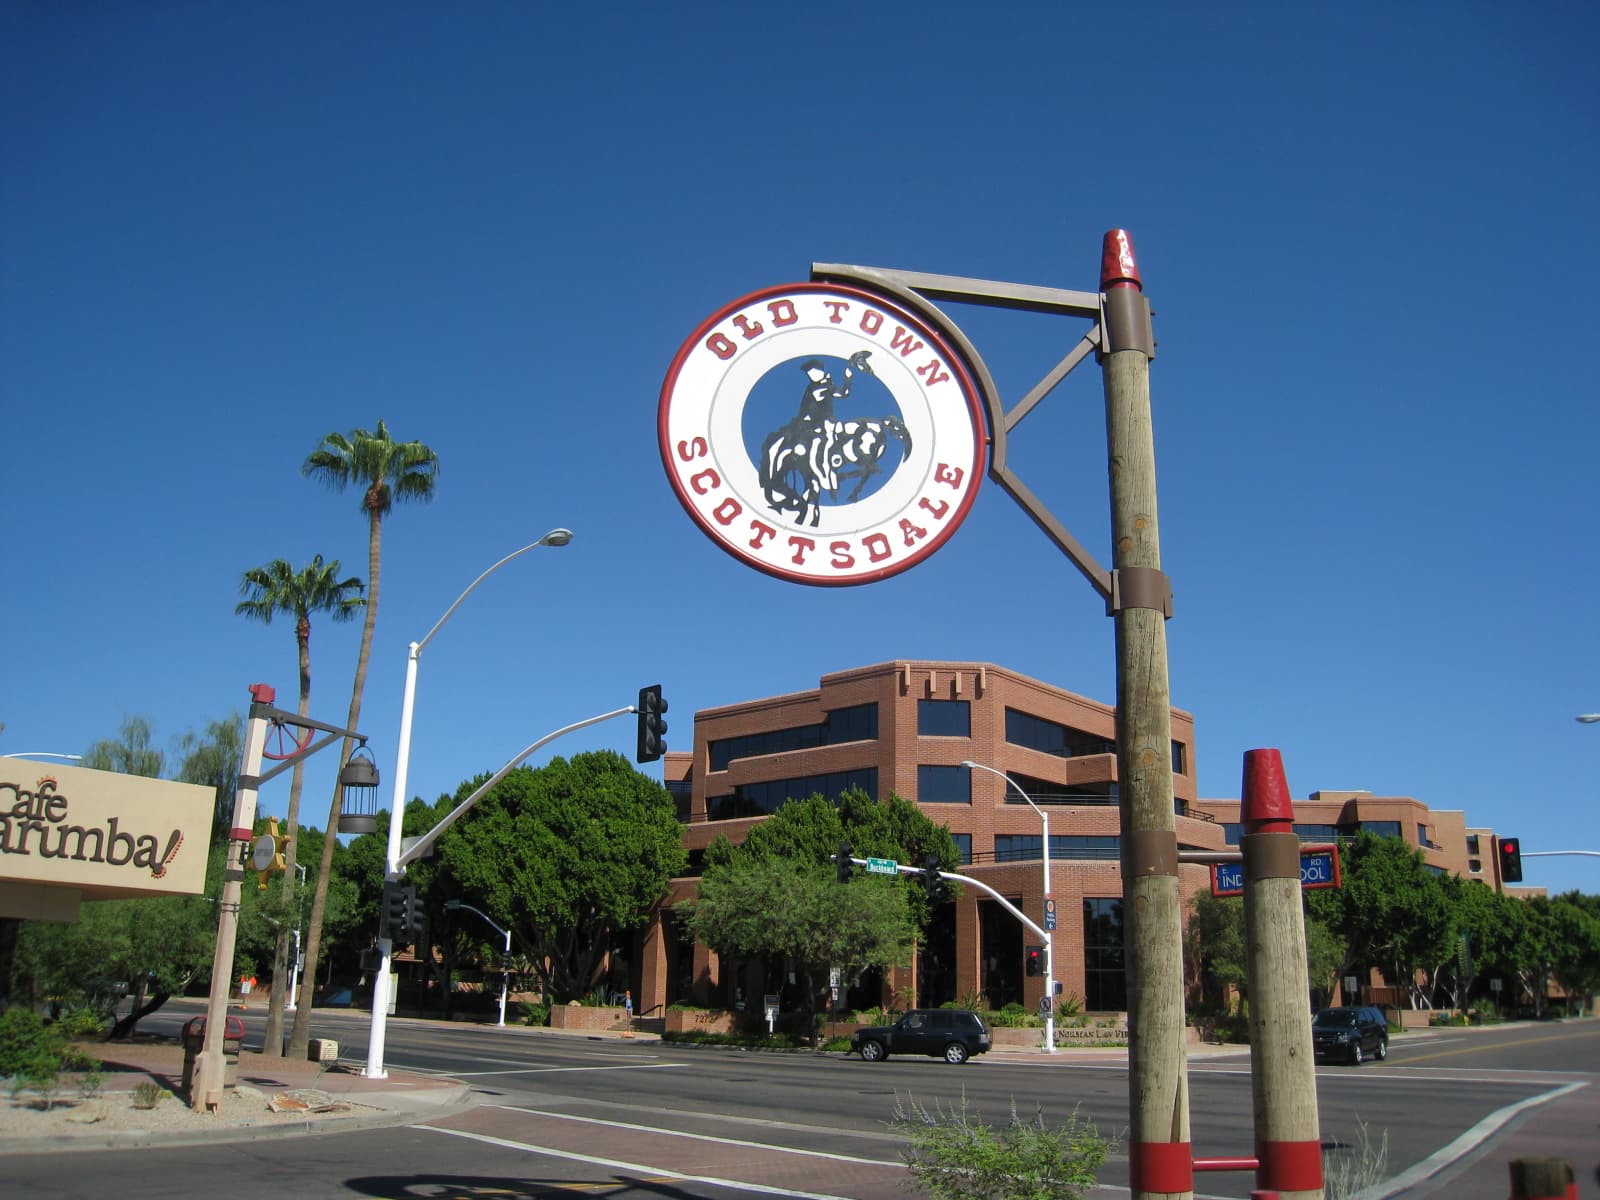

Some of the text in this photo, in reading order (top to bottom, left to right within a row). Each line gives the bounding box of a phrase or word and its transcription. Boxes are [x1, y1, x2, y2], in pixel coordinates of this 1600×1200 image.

[706, 300, 950, 387] OLD TOWN
[677, 436, 964, 569] SCOTTSDALE
[0, 817, 183, 878] arumba!
